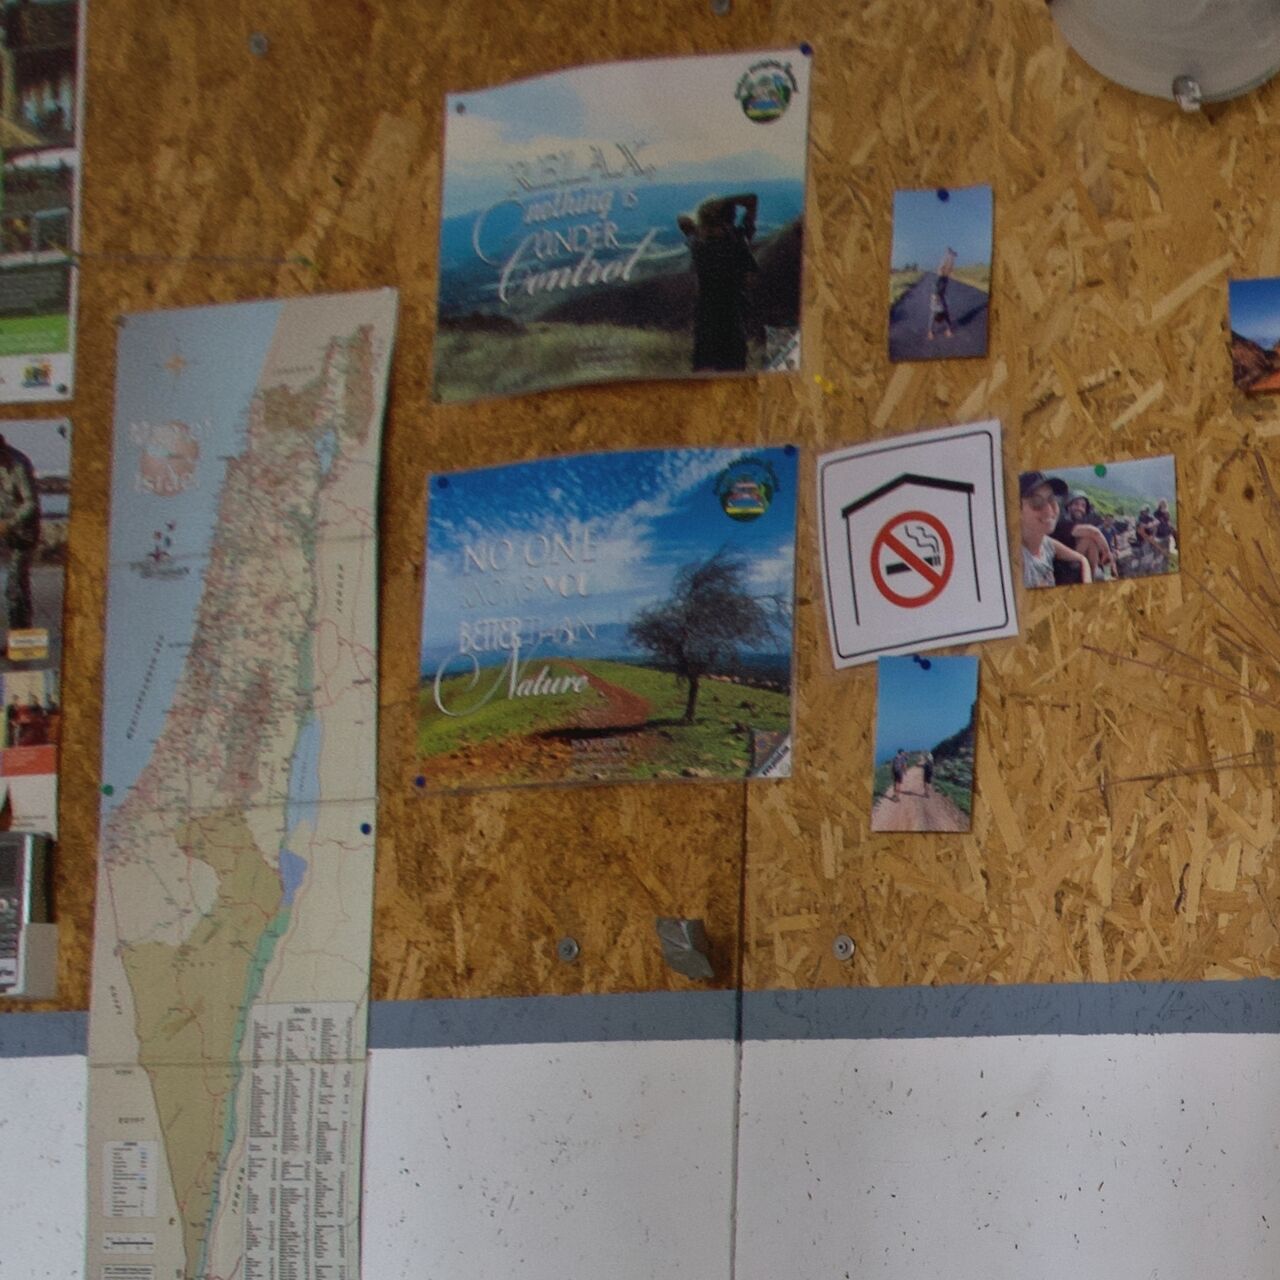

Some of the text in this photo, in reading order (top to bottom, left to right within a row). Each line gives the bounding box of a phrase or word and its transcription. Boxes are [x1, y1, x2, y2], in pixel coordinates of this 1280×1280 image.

[532, 221, 620, 259] UNDER
[463, 528, 597, 575] NO ONE
[433, 640, 590, 717] Nature
